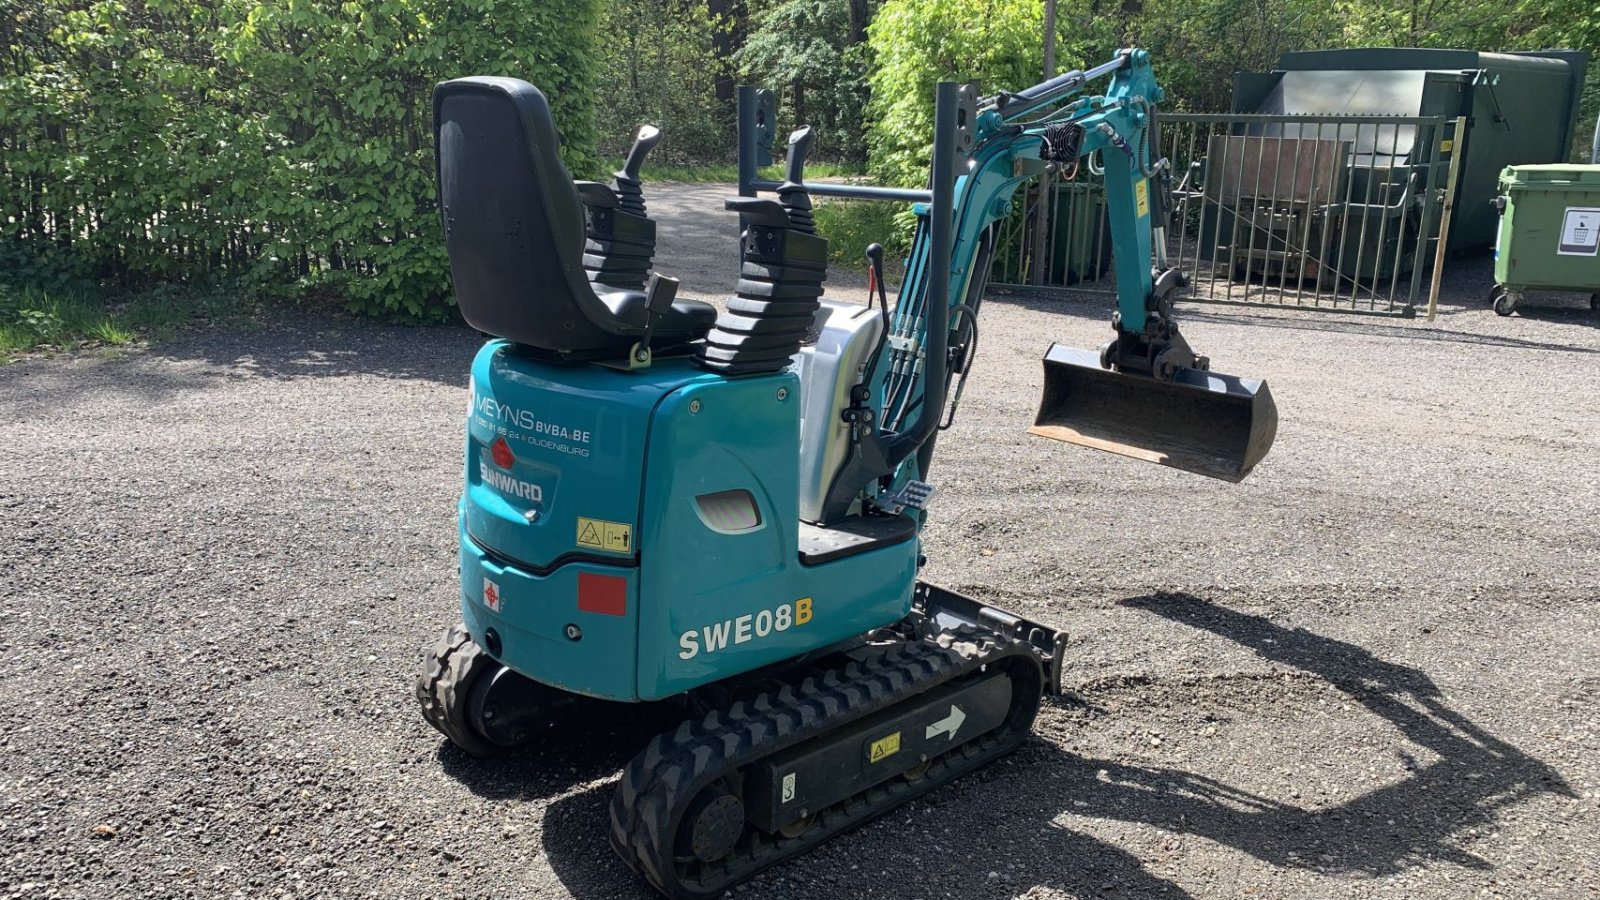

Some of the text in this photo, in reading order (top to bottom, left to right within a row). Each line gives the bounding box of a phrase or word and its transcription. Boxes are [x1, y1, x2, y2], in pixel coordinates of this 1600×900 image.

[476, 393, 534, 430] MEYNS
[528, 436, 590, 458] OUDENBURG
[480, 462, 543, 502] SUNWARD
[679, 597, 813, 660] SWE08B
